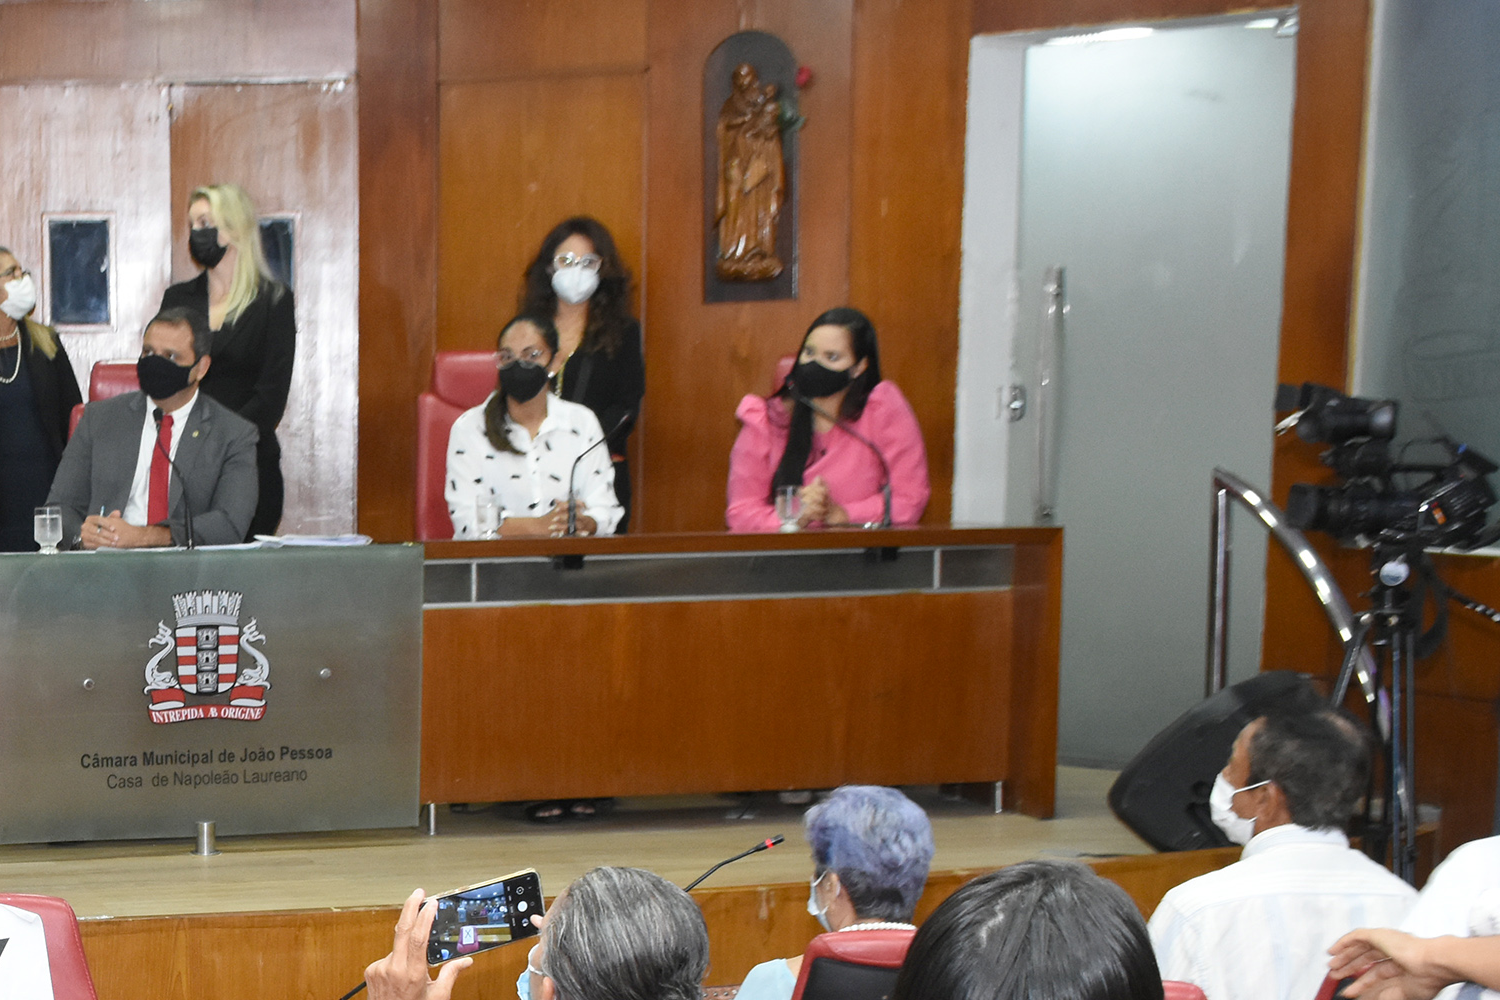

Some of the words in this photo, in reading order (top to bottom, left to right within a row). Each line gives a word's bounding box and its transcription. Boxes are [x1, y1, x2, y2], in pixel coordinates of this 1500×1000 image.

[151, 707, 204, 723] INTREPIDA
[220, 706, 264, 719] ORIGINE
[80, 753, 138, 769] Câmara
[142, 750, 214, 769] Municipal
[218, 748, 235, 763] de
[240, 746, 275, 763] João
[280, 745, 333, 761] Pessoa
[106, 773, 143, 790] Casa
[151, 772, 169, 787] de
[173, 770, 239, 789] Napoleão
[243, 767, 308, 783] Laureano
